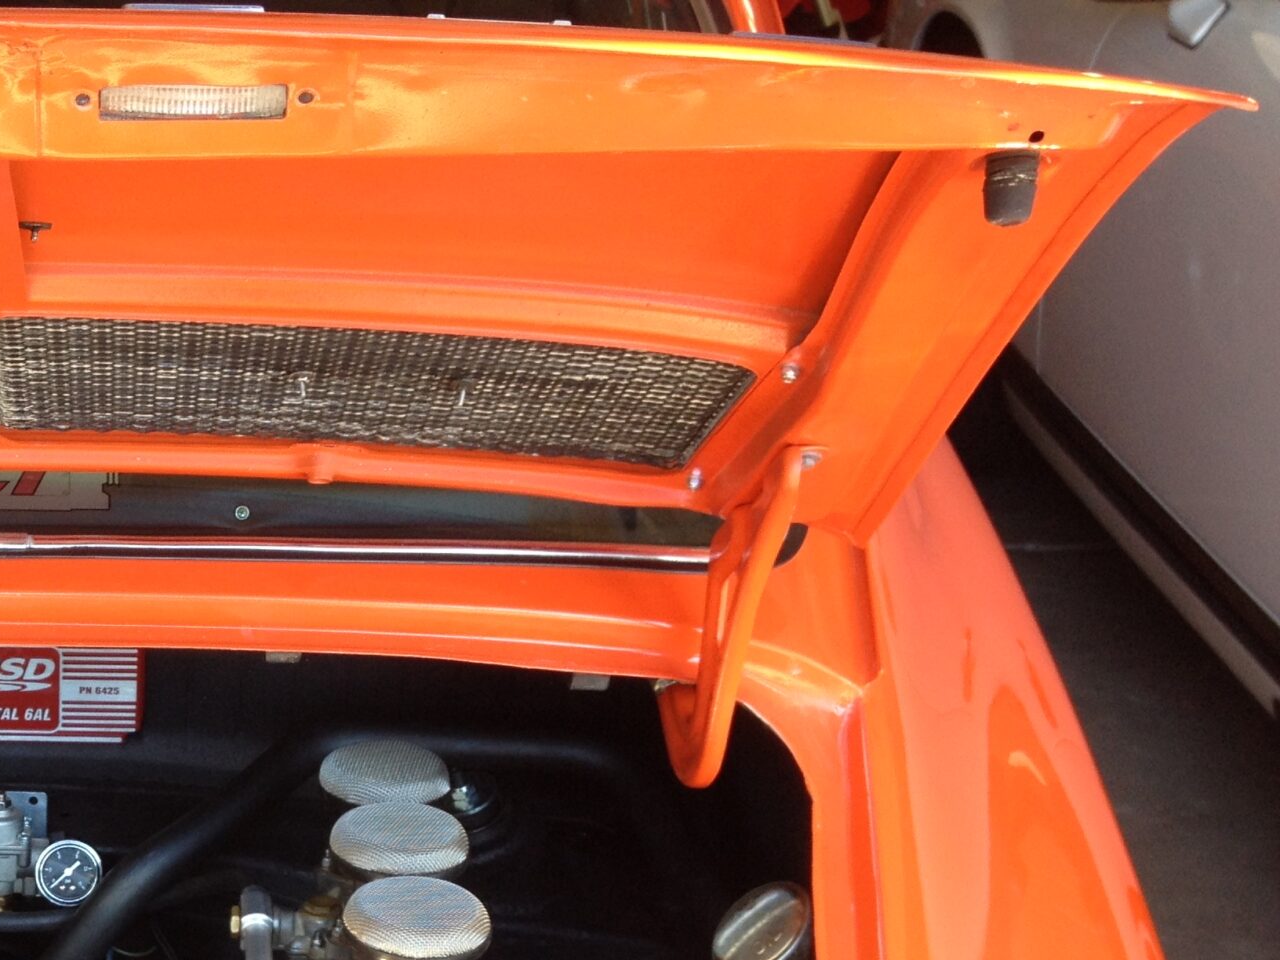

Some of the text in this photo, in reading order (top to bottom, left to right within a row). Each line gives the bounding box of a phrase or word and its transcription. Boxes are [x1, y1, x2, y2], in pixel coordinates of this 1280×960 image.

[79, 687, 120, 696] PN 6425
[24, 707, 52, 721] 6AL
